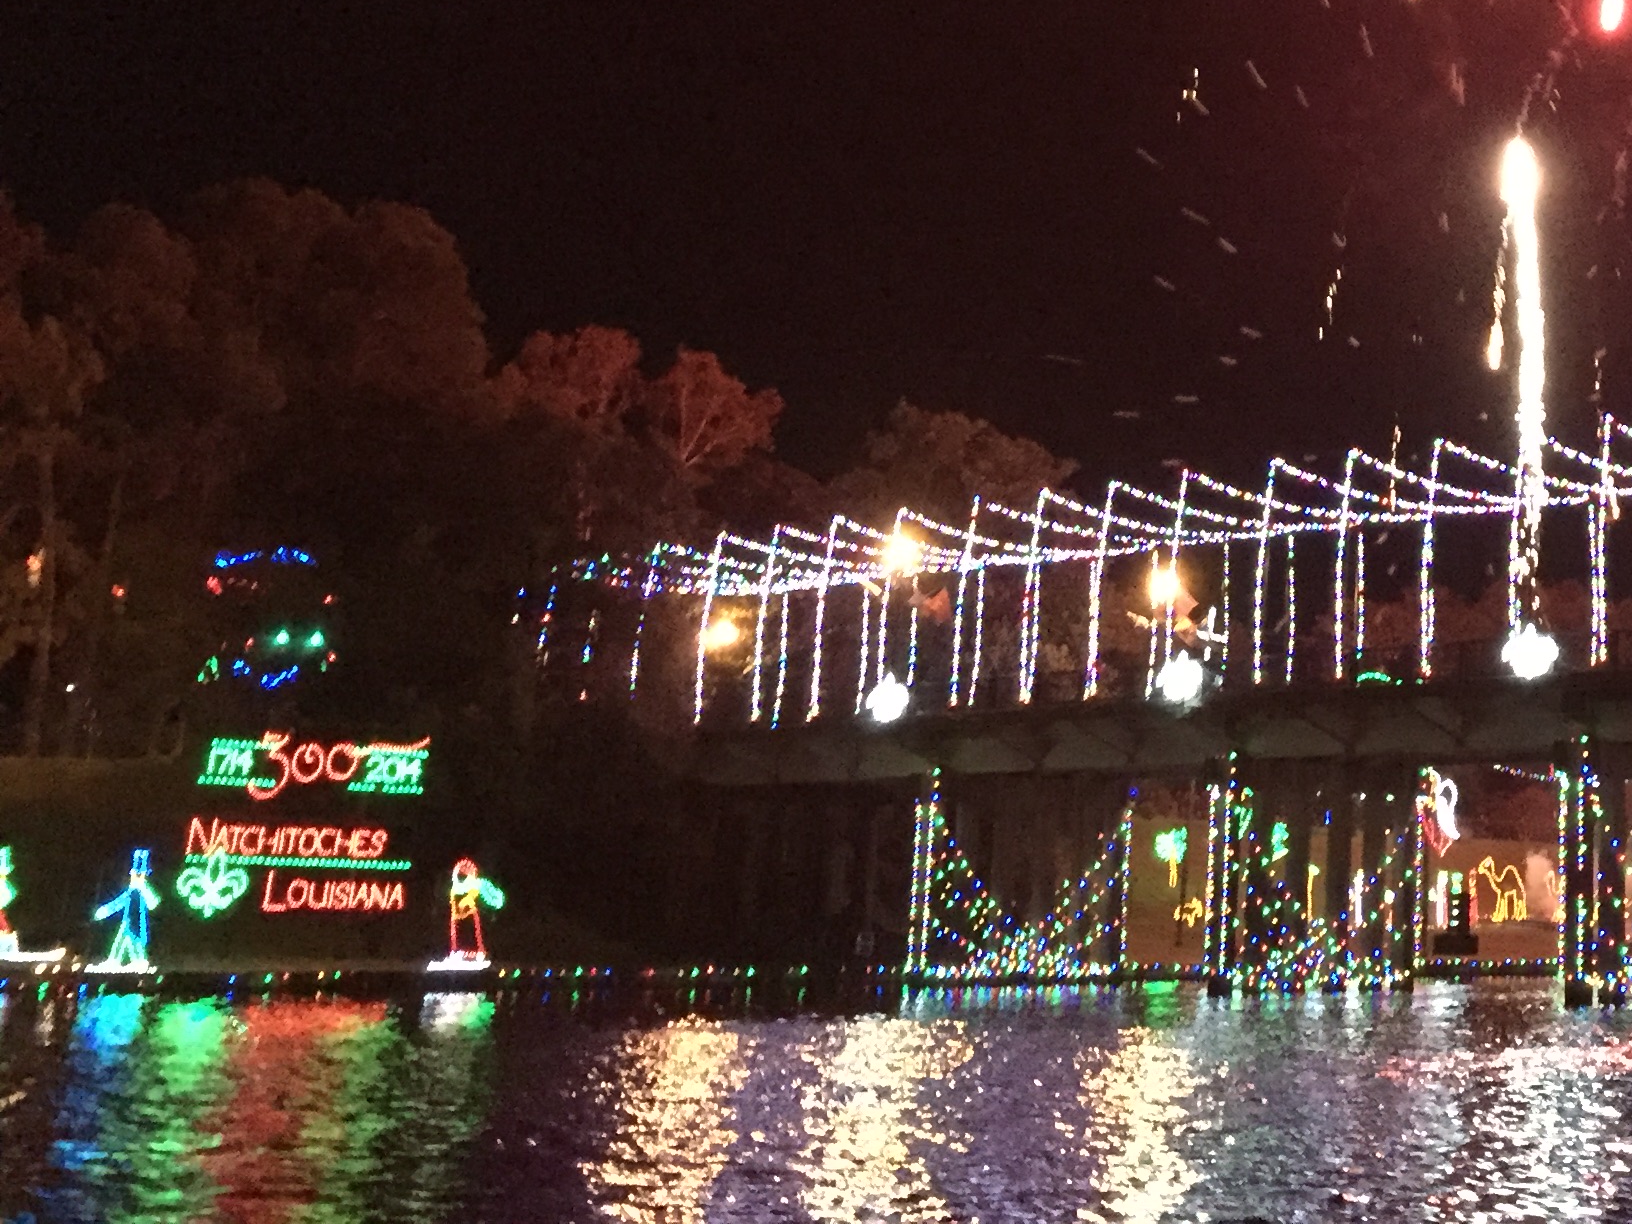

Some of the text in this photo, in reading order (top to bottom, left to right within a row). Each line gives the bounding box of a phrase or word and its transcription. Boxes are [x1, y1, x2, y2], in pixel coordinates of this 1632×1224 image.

[206, 730, 423, 800] 1714 300 2014
[185, 816, 389, 859] NATCHITOCHES
[261, 869, 406, 913] LOUISIANA
